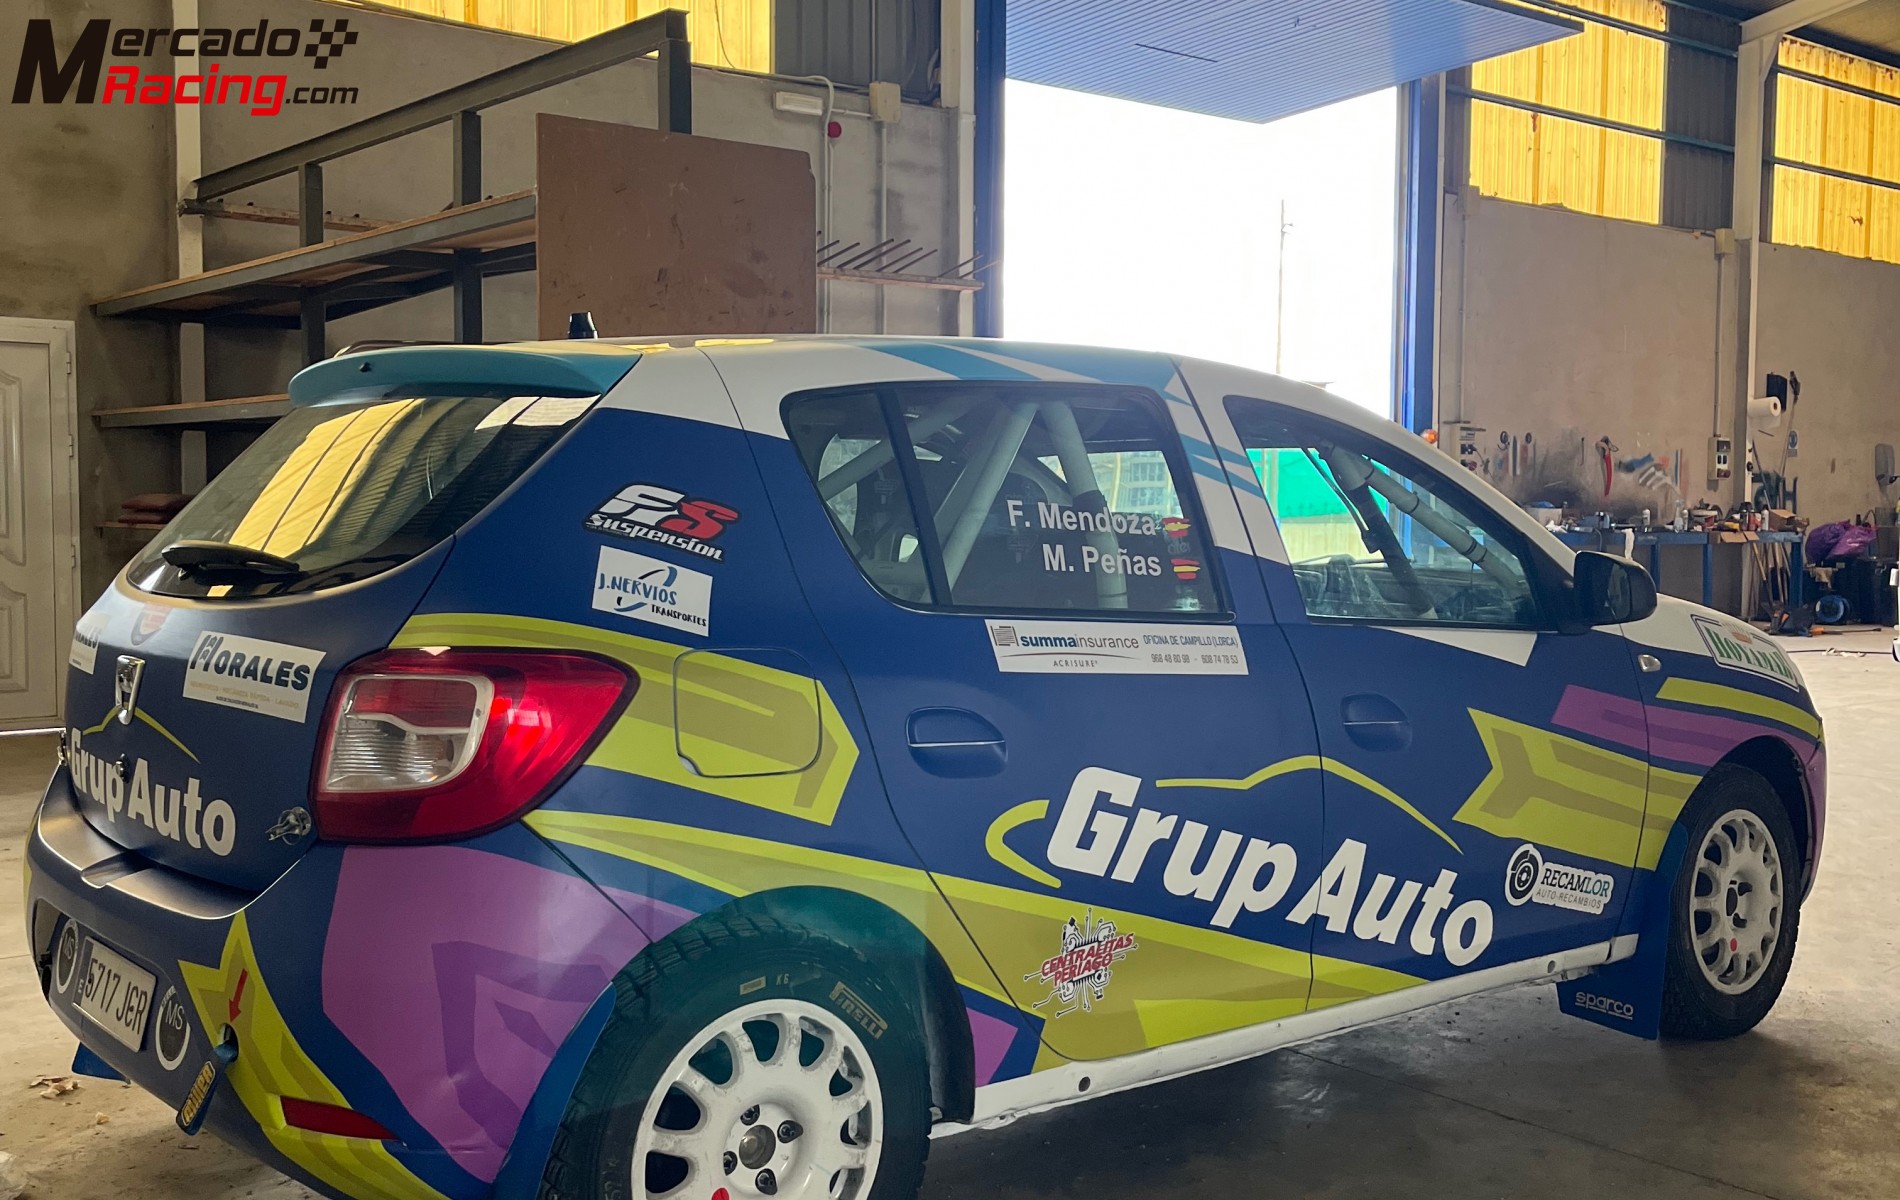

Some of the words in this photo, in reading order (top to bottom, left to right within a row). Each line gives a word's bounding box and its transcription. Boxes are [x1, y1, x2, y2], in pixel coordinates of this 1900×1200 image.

[1007, 499, 1031, 528] F.
[1038, 502, 1157, 536] Mendoza
[586, 513, 723, 561] Suspension
[1042, 543, 1075, 572] M.
[1082, 545, 1162, 576] Peñas
[598, 573, 678, 606] J.NERVIOS
[651, 603, 707, 627] TRANSPORTES
[1143, 635, 1169, 645] OFICINA
[1170, 635, 1179, 645] DE
[1180, 636, 1212, 646] CAMPILLO
[190, 634, 311, 691] MORALES
[1540, 868, 1610, 898] RECAMLOR
[1041, 933, 1134, 977] CENTRALITAS
[1053, 952, 1113, 987] PERIAGO
[85, 957, 121, 1014] 5717
[116, 981, 148, 1035] JER
[1575, 991, 1634, 1017] sparco
[165, 1001, 185, 1030] MS
